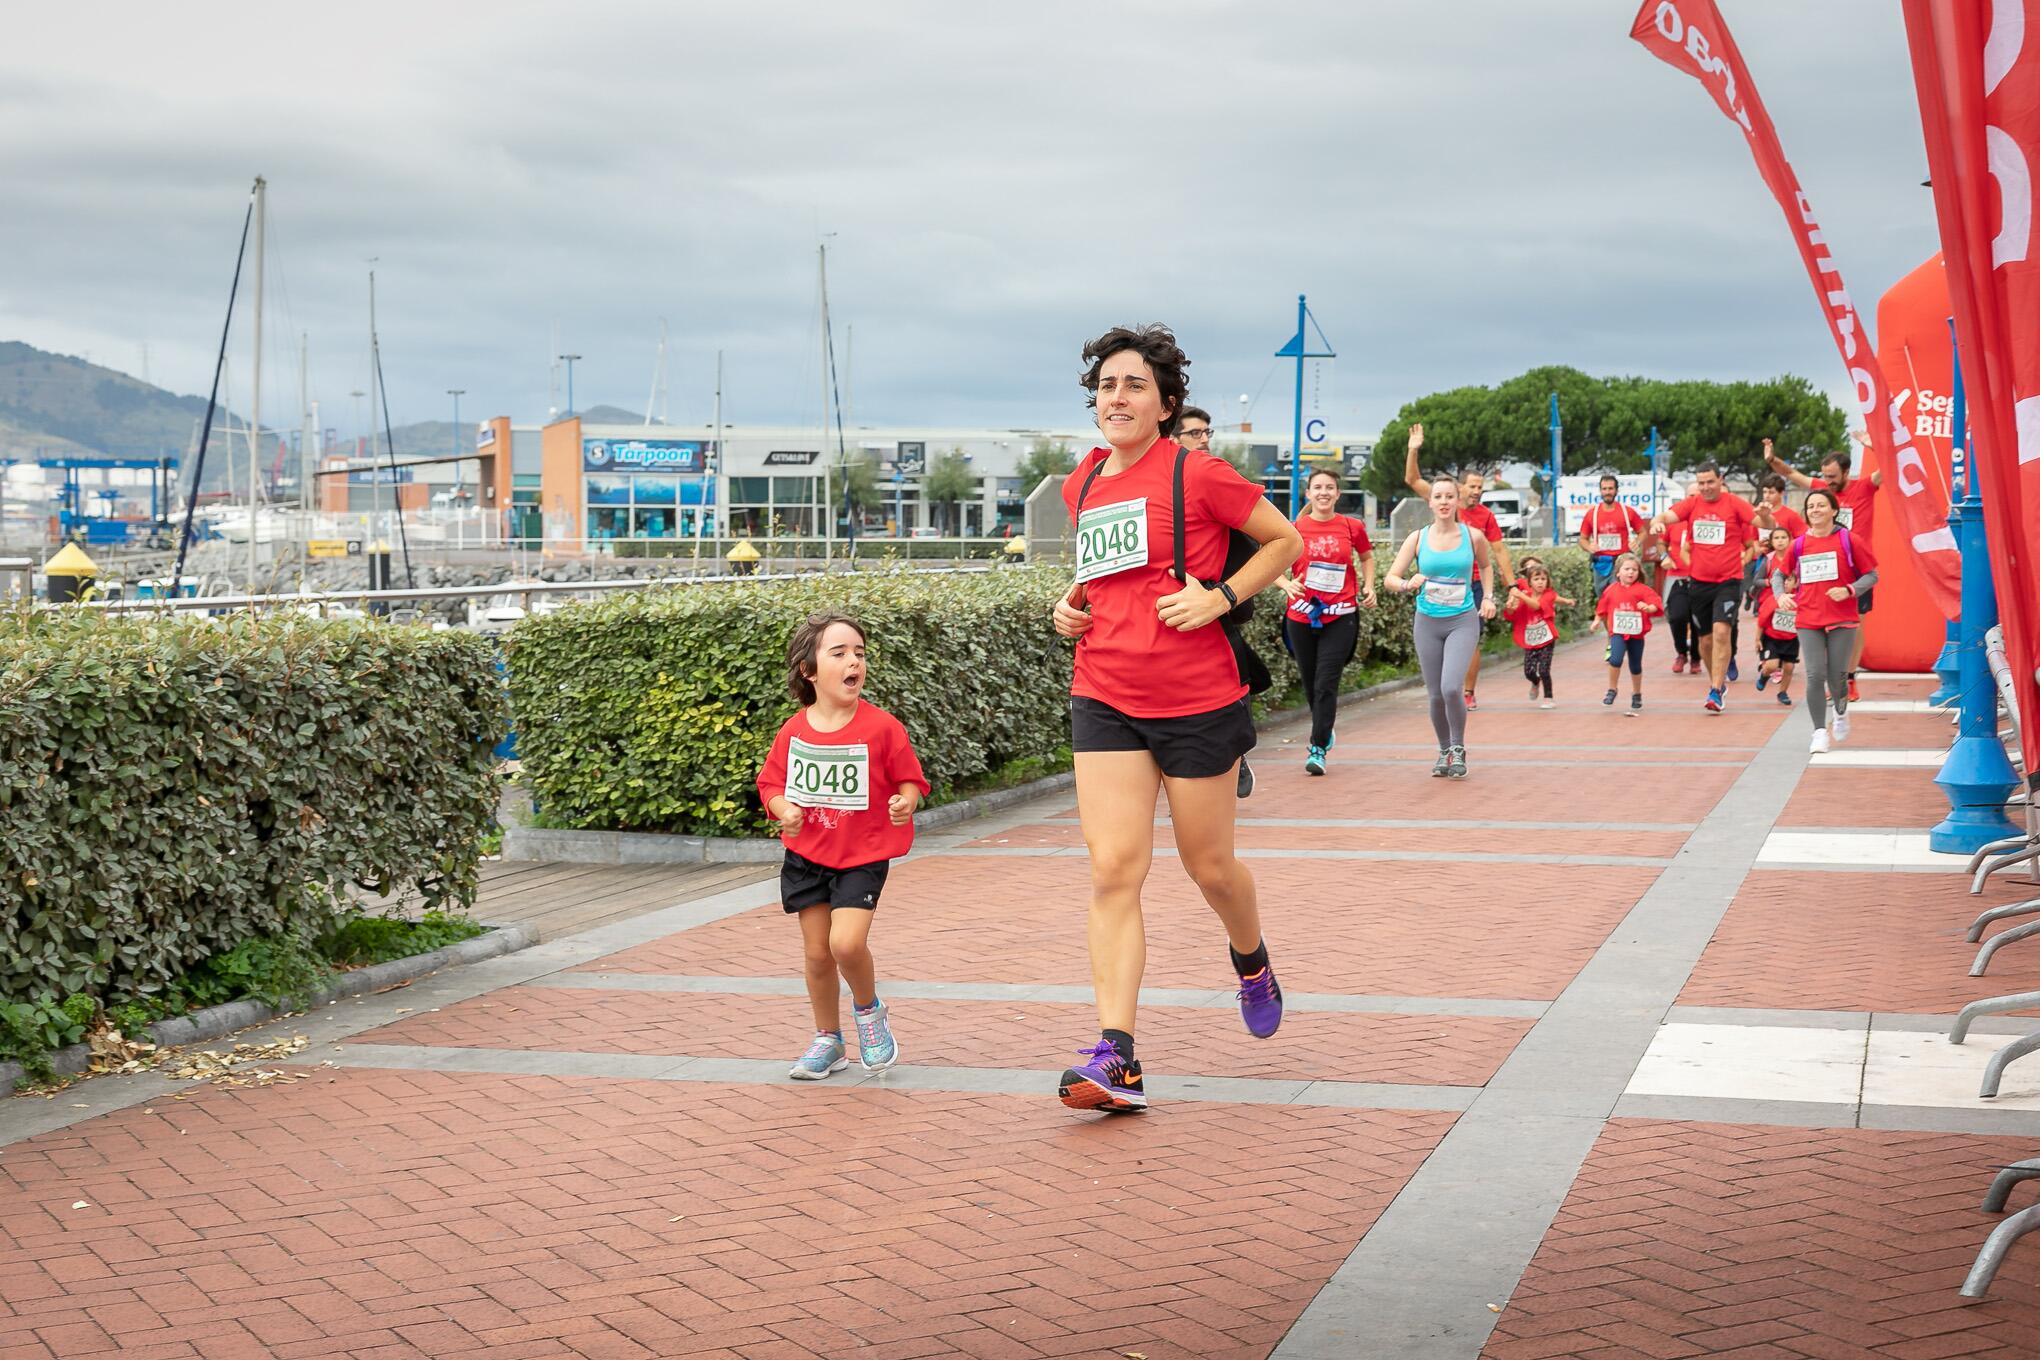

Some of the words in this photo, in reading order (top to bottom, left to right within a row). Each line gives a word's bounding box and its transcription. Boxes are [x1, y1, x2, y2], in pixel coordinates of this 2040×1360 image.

[1306, 419, 1325, 442] C
[612, 444, 692, 466] Tarpoon
[1080, 519, 1139, 565] 2048
[1696, 526, 1720, 539] 2051
[1775, 614, 1795, 628] 206
[793, 758, 859, 794] 2048
